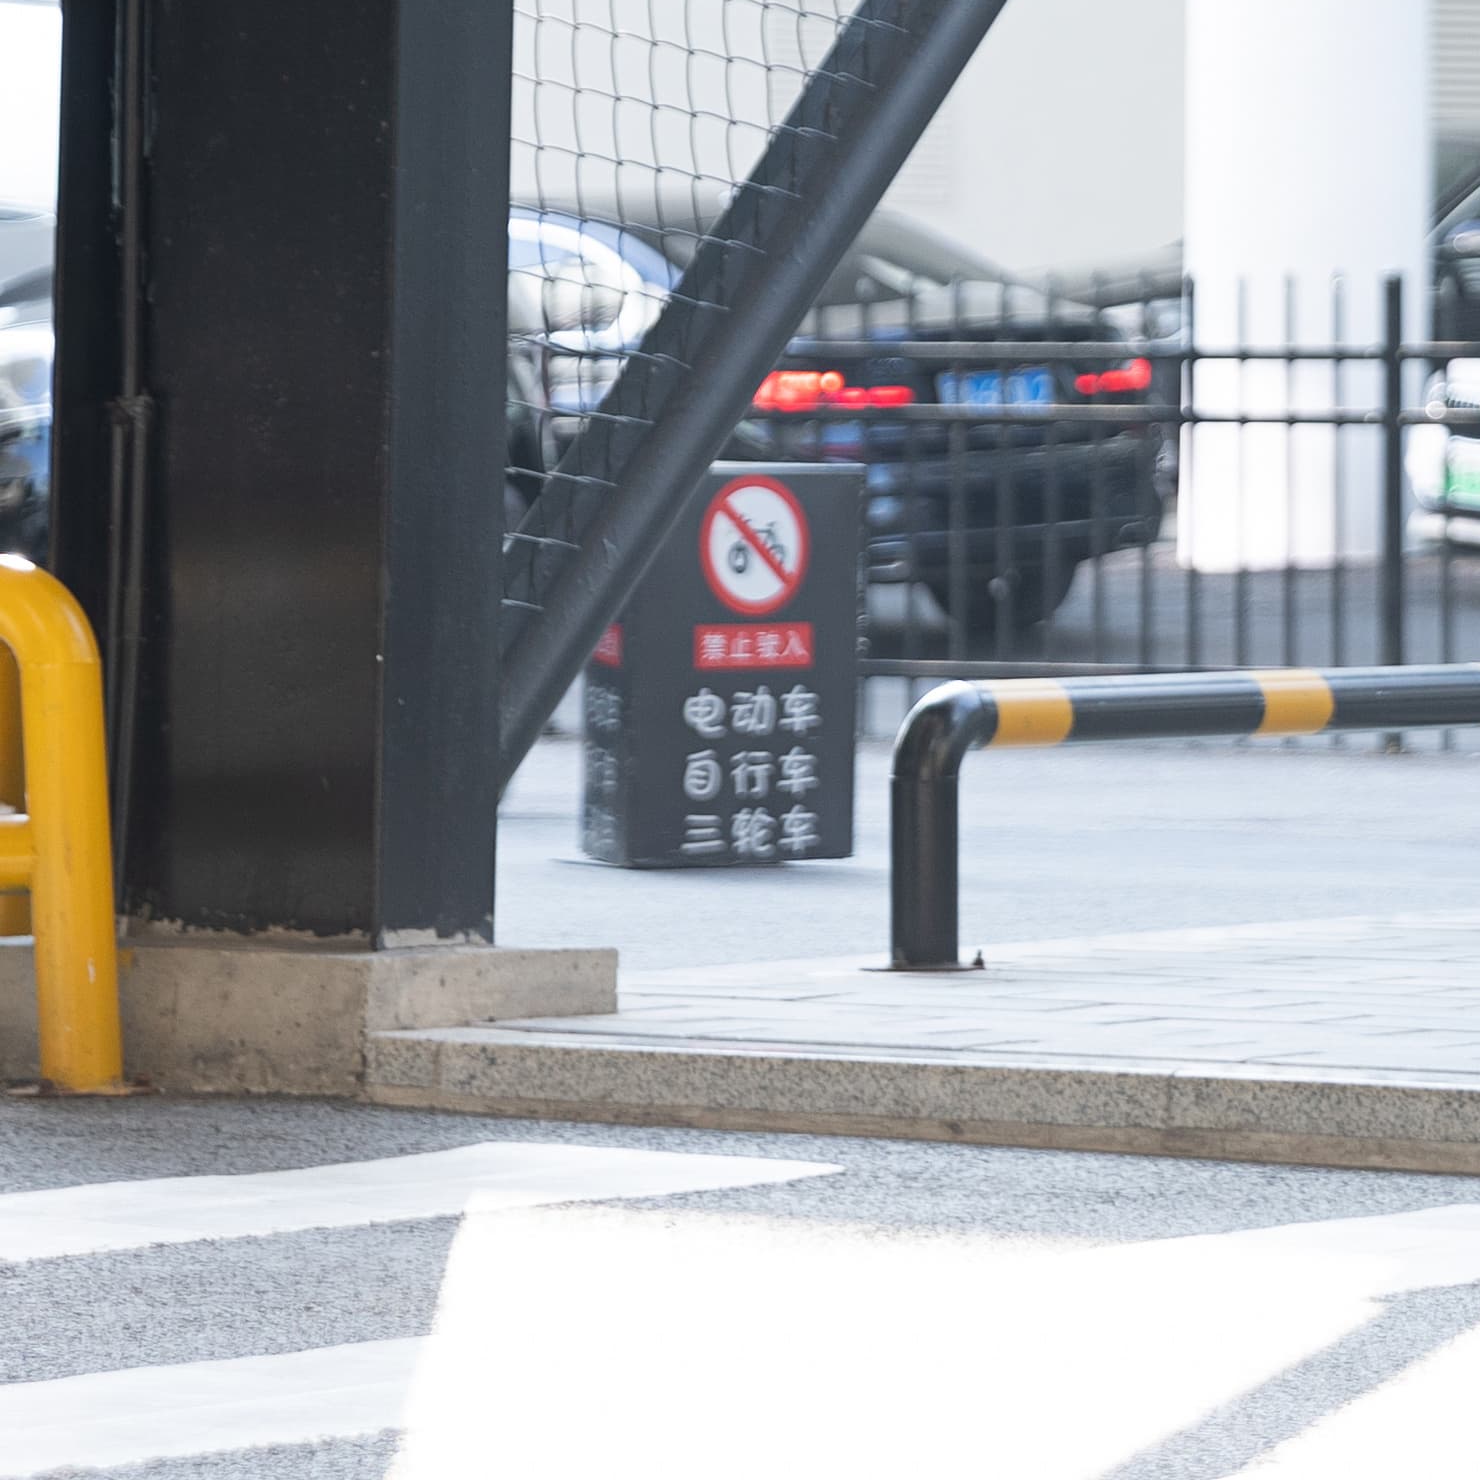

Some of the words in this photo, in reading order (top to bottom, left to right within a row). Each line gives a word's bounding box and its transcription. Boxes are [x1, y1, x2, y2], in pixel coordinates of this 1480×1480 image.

[701, 631, 810, 661] 禁止驶入
[683, 684, 822, 739] 电动车
[683, 746, 821, 801] 自行车
[680, 804, 822, 857] 三轮车
